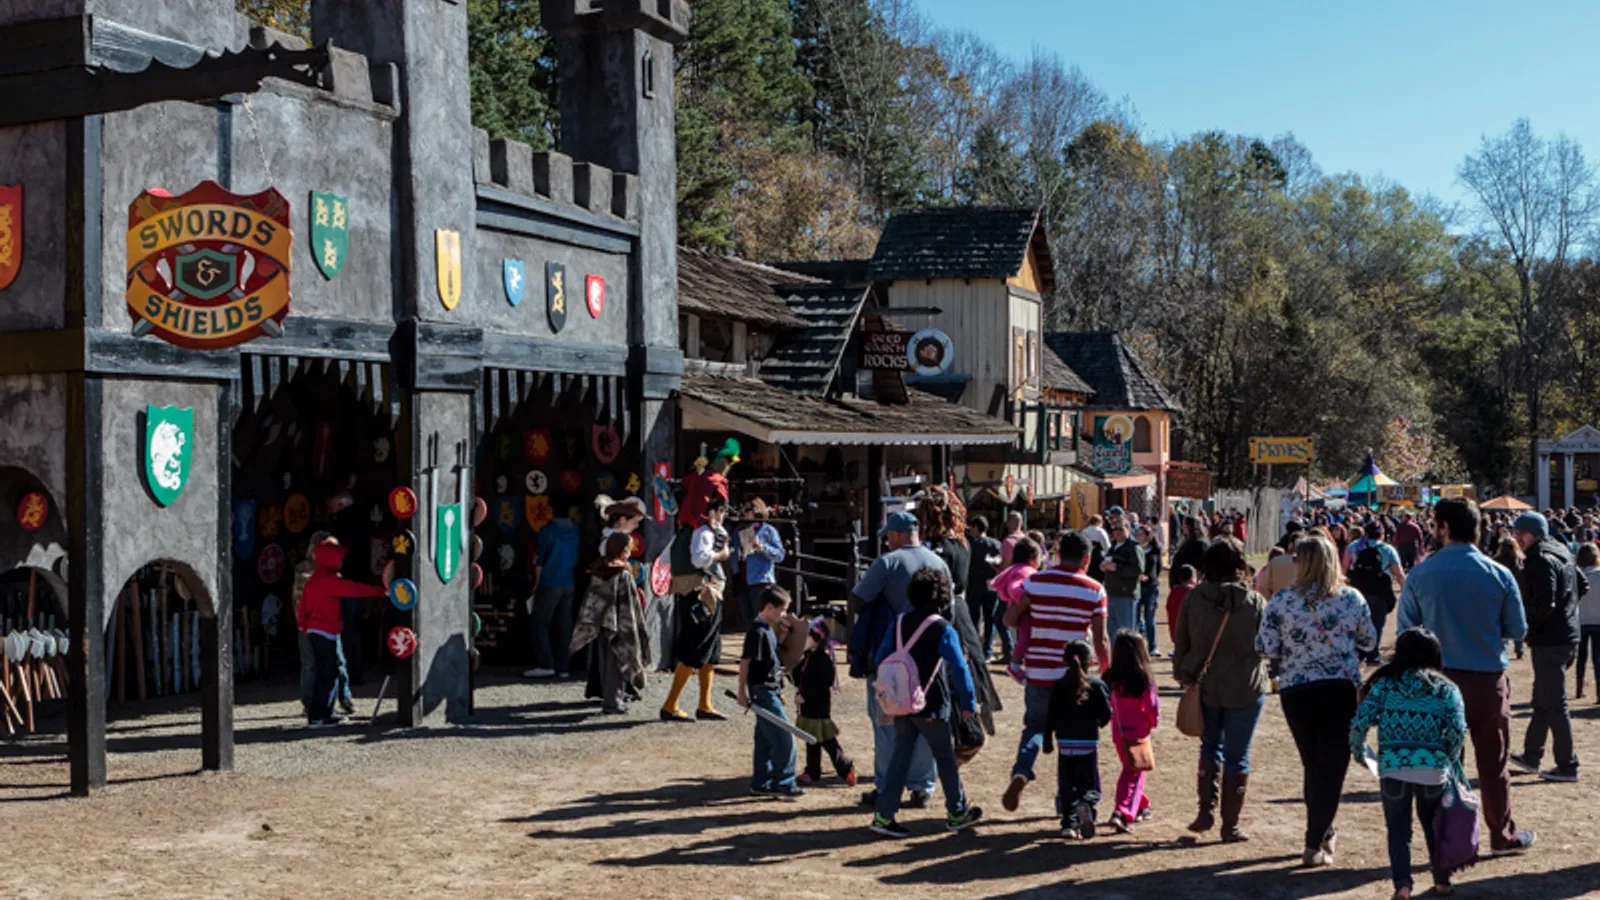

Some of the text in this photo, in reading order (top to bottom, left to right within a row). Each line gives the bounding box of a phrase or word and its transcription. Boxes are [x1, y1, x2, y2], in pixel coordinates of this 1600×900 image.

[139, 209, 276, 249] SWORDS
[196, 257, 222, 287] &
[144, 294, 263, 335] SHIELDS
[864, 354, 907, 368] ROCKS
